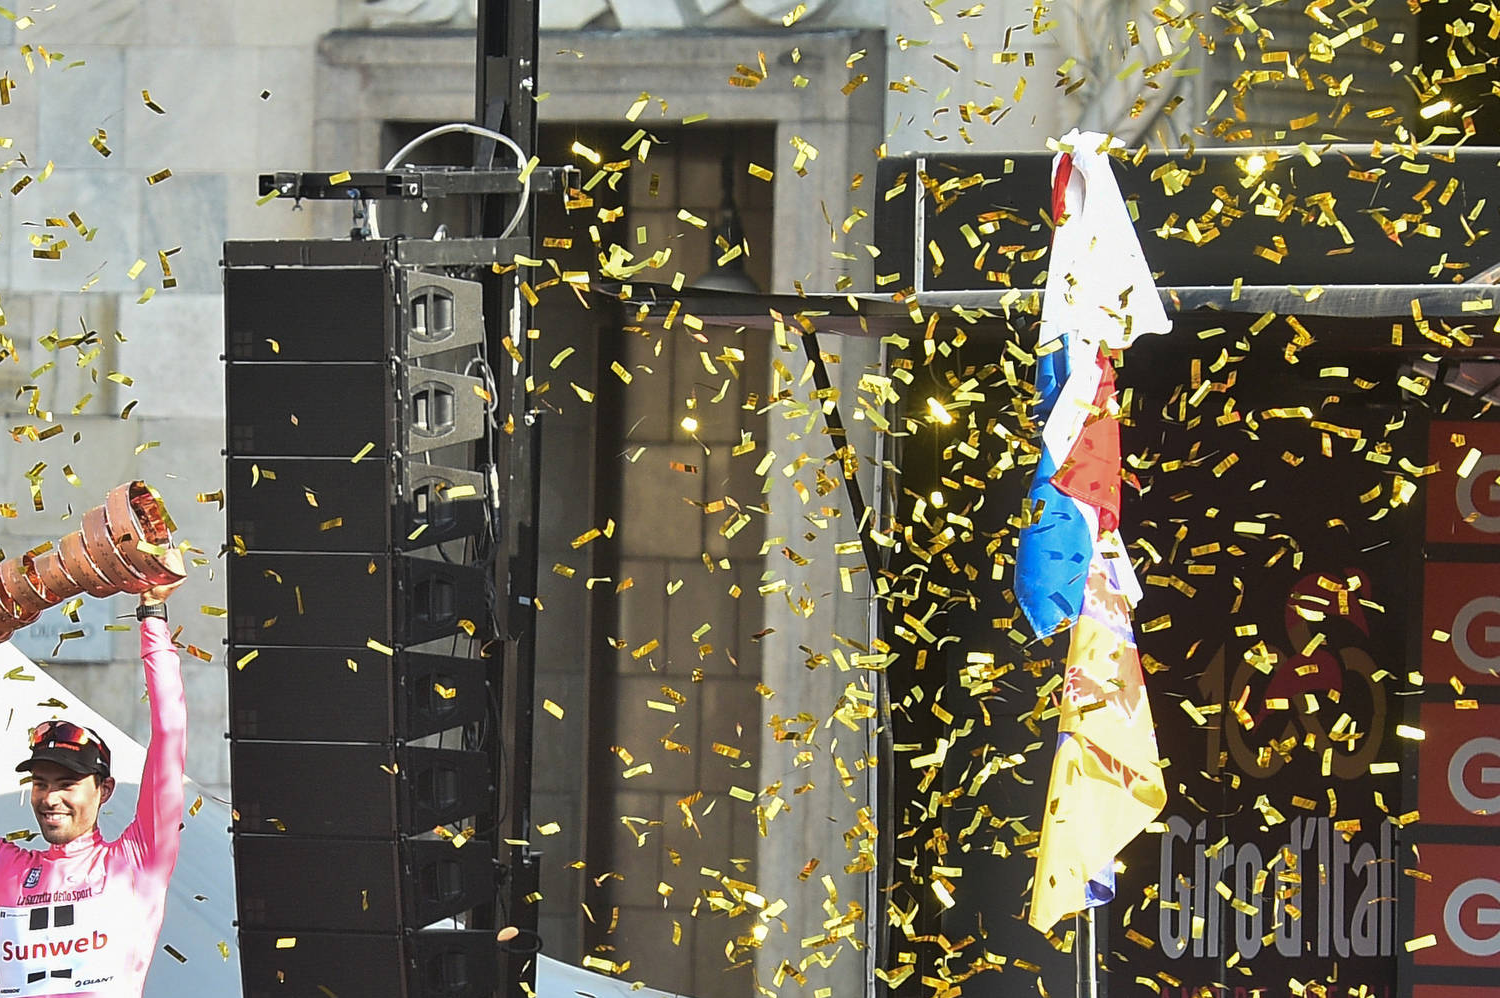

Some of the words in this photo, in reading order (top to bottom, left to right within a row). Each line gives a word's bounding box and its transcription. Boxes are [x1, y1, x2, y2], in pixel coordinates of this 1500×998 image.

[72, 887, 92, 901] Sport
[1159, 815, 1263, 960] Giro
[1275, 815, 1398, 958] d'Ital
[3, 930, 108, 961] Sunweb
[82, 976, 114, 986] GIANT
